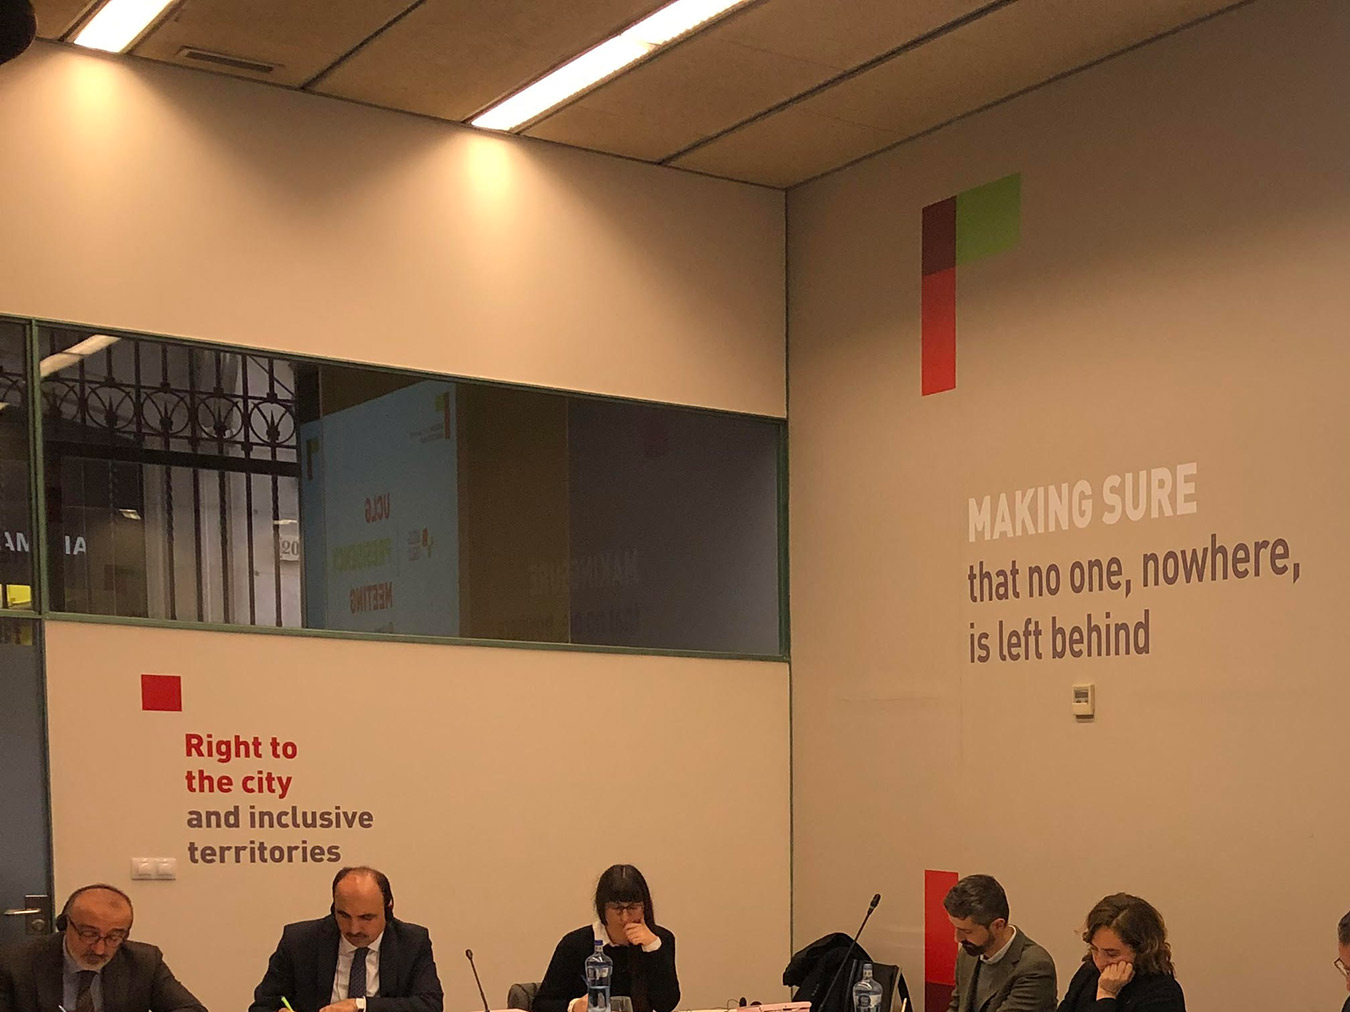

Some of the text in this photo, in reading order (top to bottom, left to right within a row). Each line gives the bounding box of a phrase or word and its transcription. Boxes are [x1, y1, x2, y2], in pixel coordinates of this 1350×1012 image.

[968, 462, 1198, 543] MAKING SURE
[968, 533, 1301, 603] that no one, nowhere,
[969, 608, 1150, 664] is left behind
[185, 733, 298, 764] Right to
[185, 769, 292, 800] the city
[186, 805, 374, 829] and inclusive
[188, 840, 342, 864] territories
